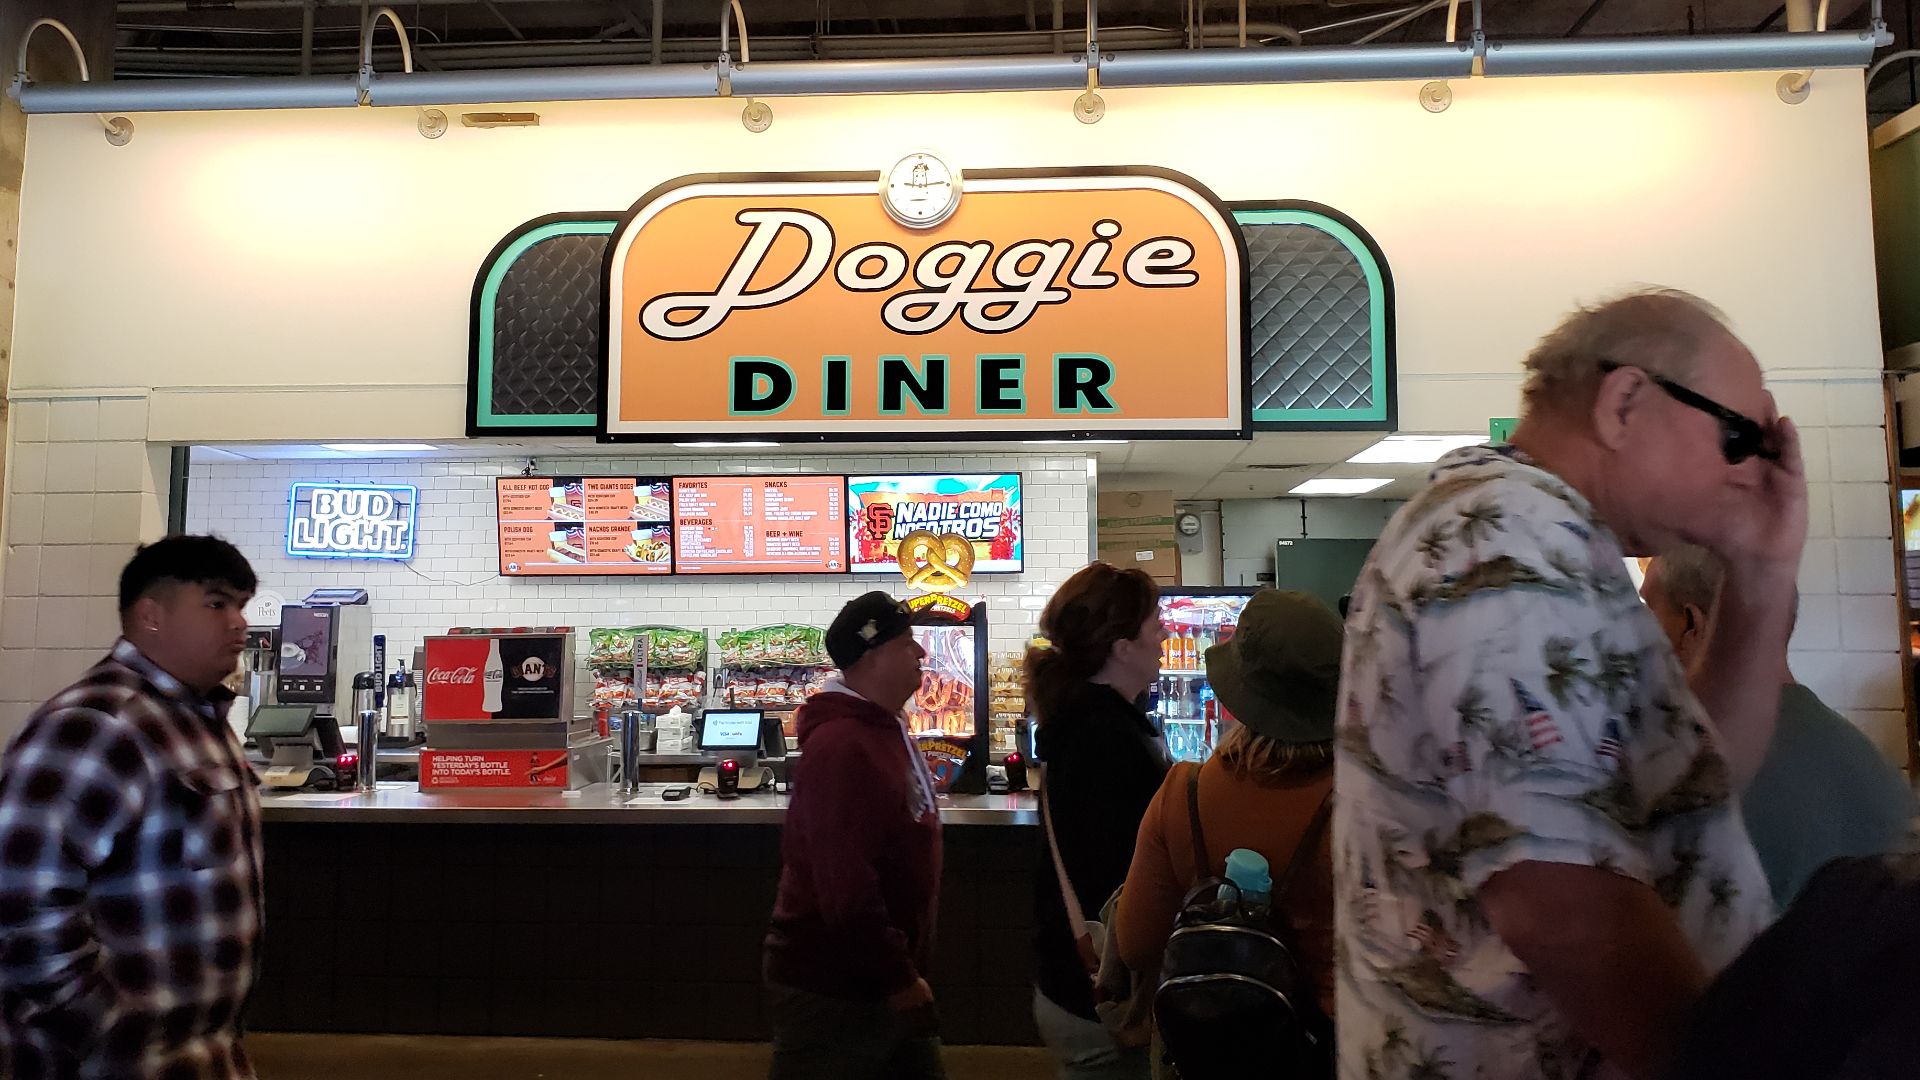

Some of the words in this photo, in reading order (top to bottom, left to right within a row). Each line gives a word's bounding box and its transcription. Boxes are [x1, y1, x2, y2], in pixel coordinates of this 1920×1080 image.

[640, 207, 1200, 341] Doggie
[728, 353, 1123, 416] DINER
[311, 488, 394, 521] BUD
[896, 502, 959, 524] NADIE
[959, 501, 1003, 519] COMO
[292, 517, 408, 550] LIGHT
[589, 525, 610, 533] NACHOS
[680, 518, 713, 526] BEVERAGES
[909, 594, 968, 614] UPERPRETZEL
[374, 645, 383, 672] LIGHT
[374, 672, 383, 693] BUD
[427, 666, 479, 685] Coca-Cola
